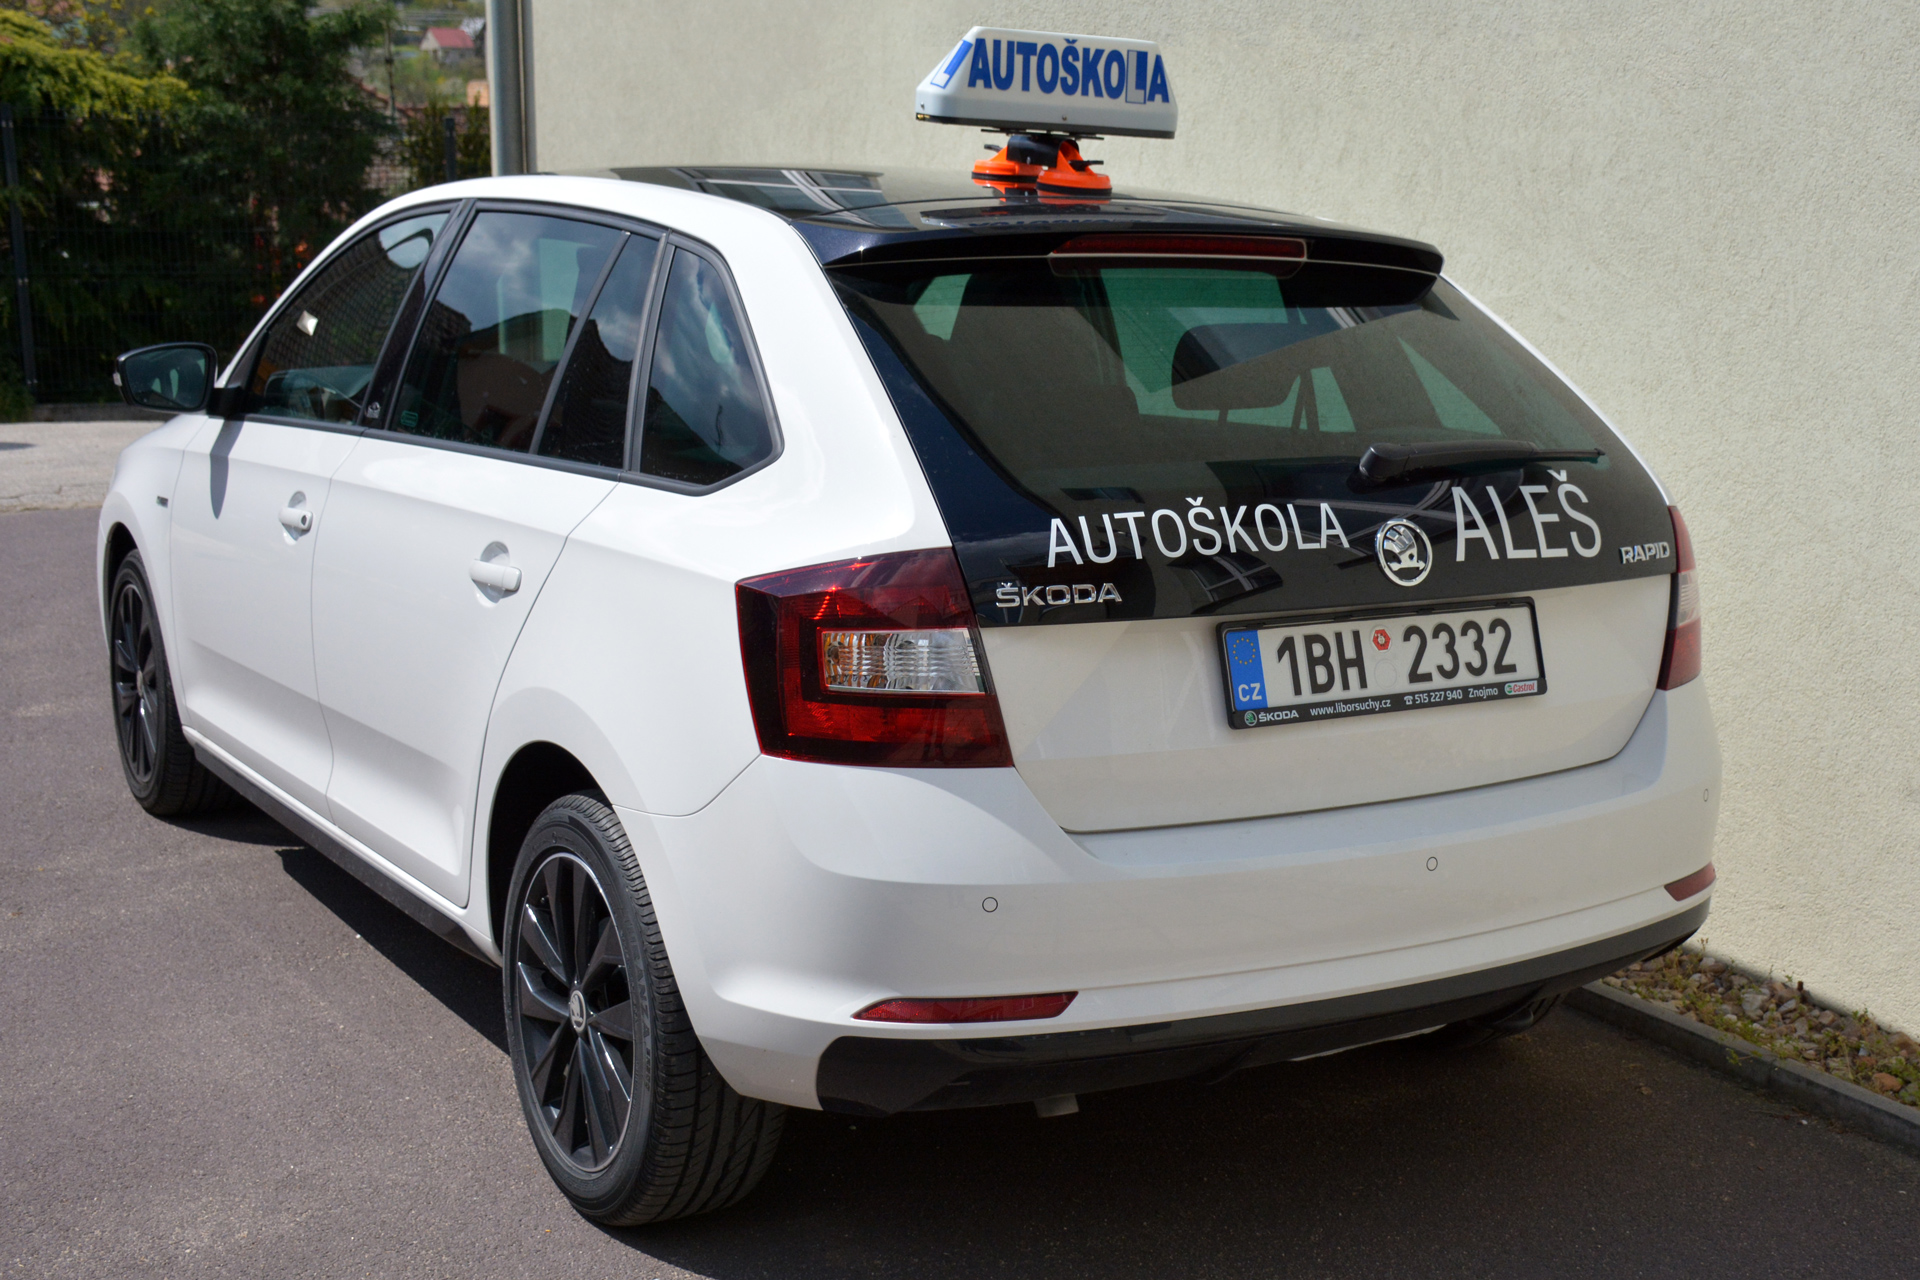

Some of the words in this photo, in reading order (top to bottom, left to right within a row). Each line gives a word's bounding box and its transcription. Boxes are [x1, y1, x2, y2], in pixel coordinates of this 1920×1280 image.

[968, 38, 1170, 104] AUTOŠKOLA
[1047, 497, 1350, 568] AUTOŠKOLA
[1451, 470, 1602, 562] ALEŠ
[1620, 541, 1670, 564] RAPID
[995, 582, 1123, 608] ŠKODA
[1276, 630, 1368, 696] 1BH
[1403, 618, 1517, 684] 2332
[1238, 683, 1262, 702] CZ
[1258, 710, 1299, 722] ŠKODA
[1310, 699, 1391, 716] www.liborsuchy.cz
[1415, 693, 1429, 704] 515
[1430, 691, 1444, 702] 227
[1446, 689, 1463, 700] 940
[1468, 687, 1498, 699] Znojmo
[1513, 682, 1535, 693] Castrol
